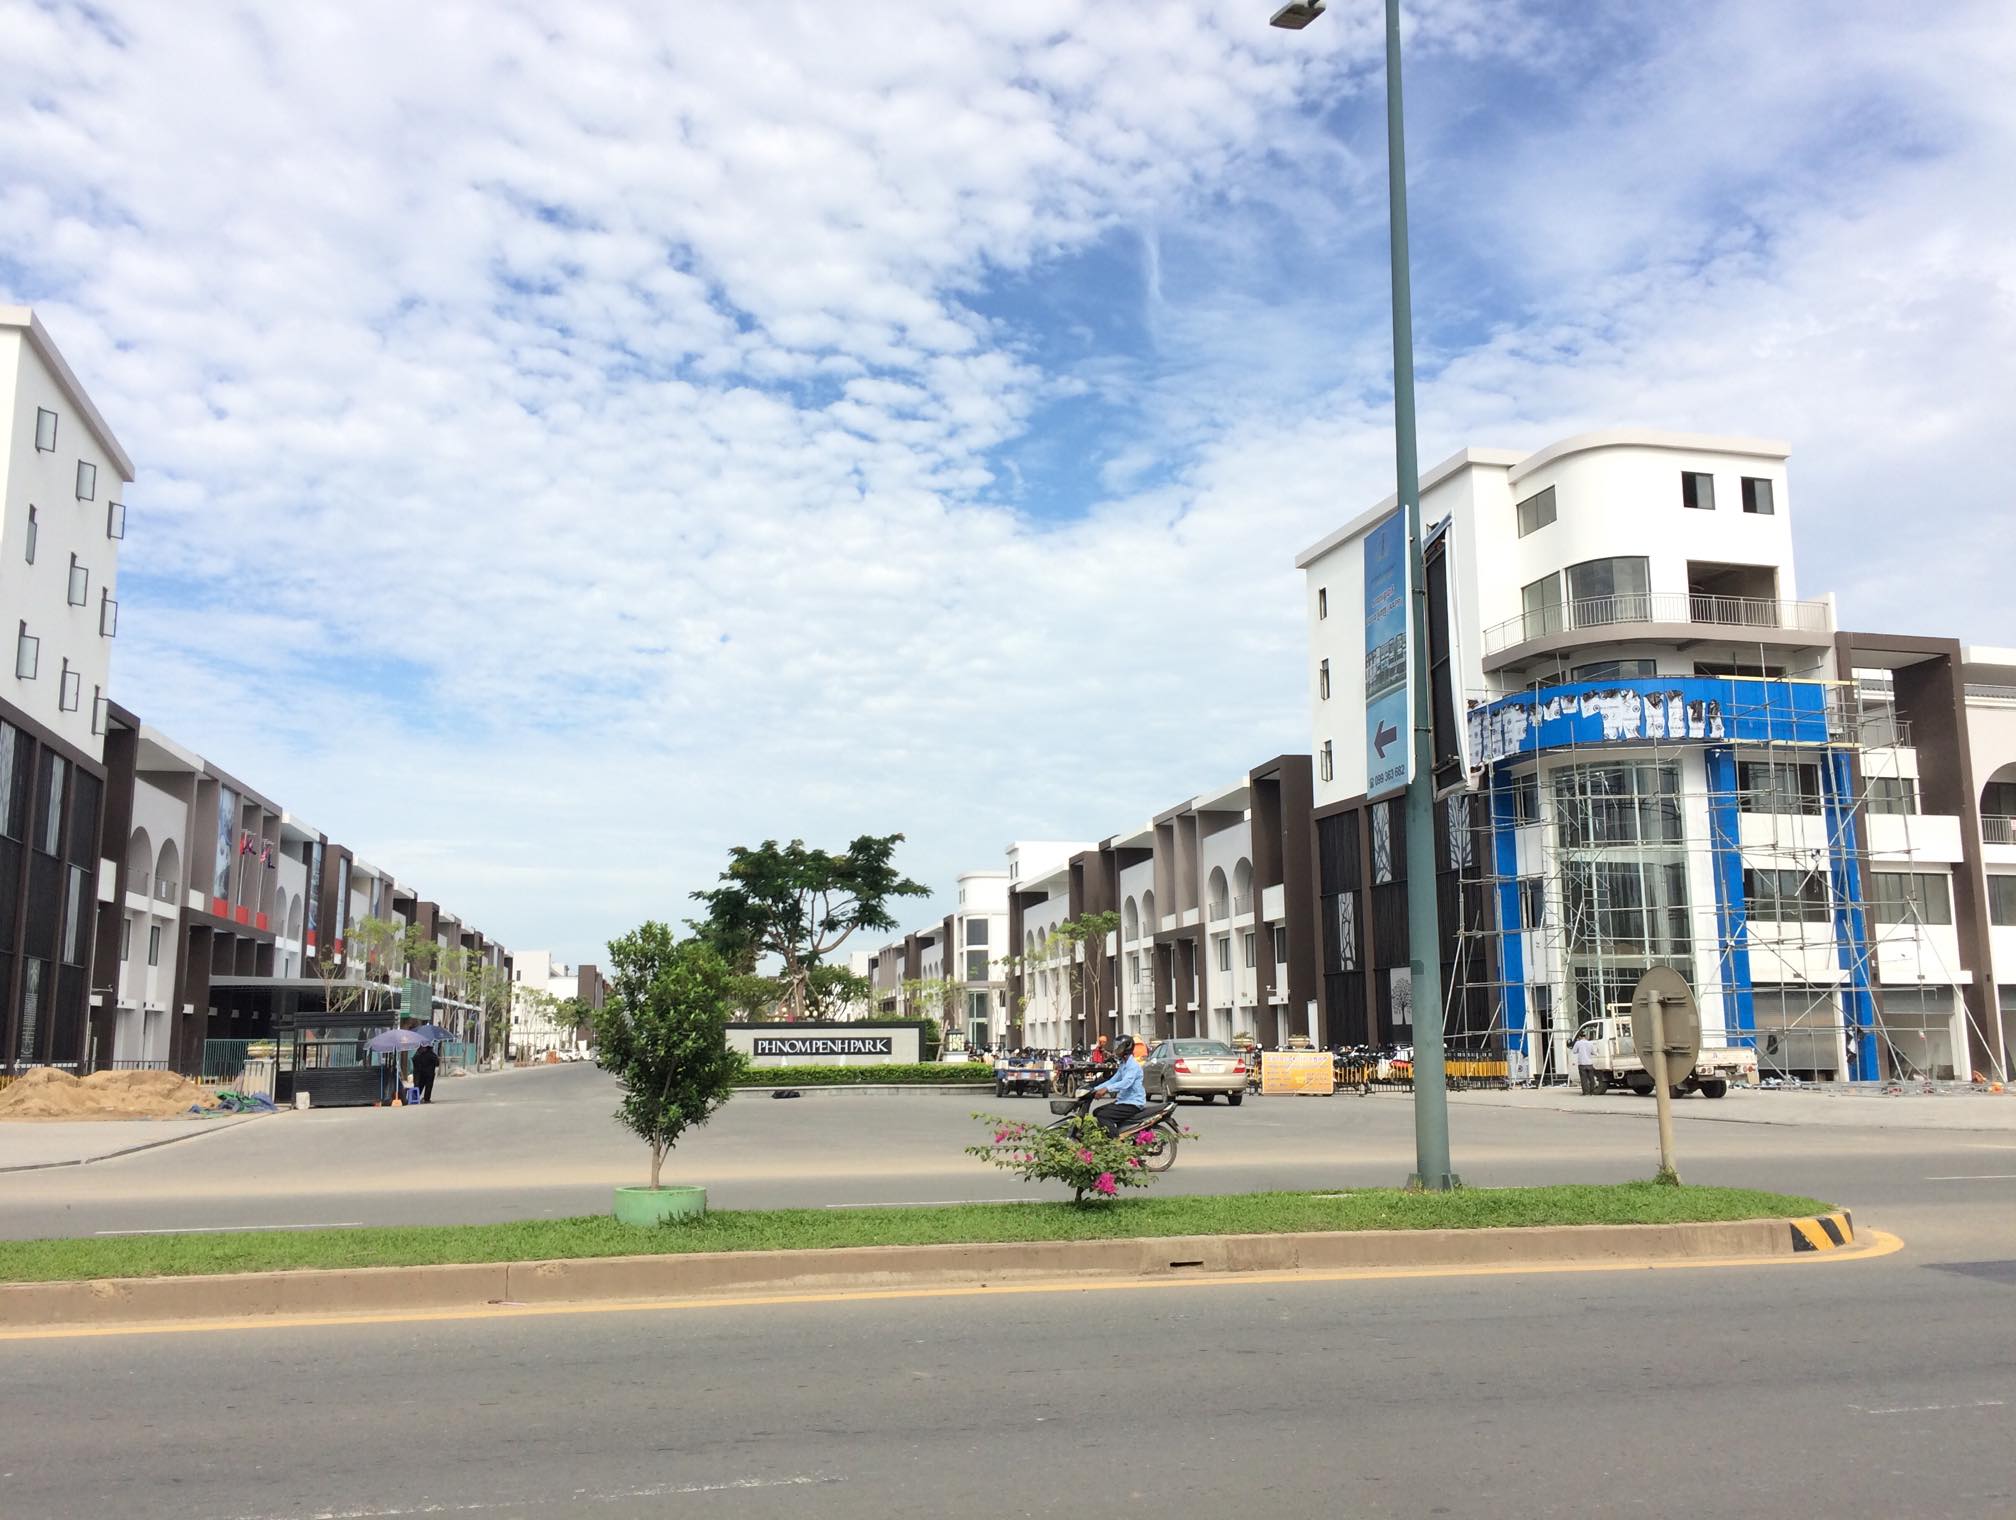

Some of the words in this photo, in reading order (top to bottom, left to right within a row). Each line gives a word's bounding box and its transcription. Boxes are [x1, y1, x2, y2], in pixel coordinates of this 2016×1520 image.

[757, 1040, 811, 1053] PHNOM
[812, 1040, 848, 1053] PENH
[850, 1039, 888, 1052] PARK
